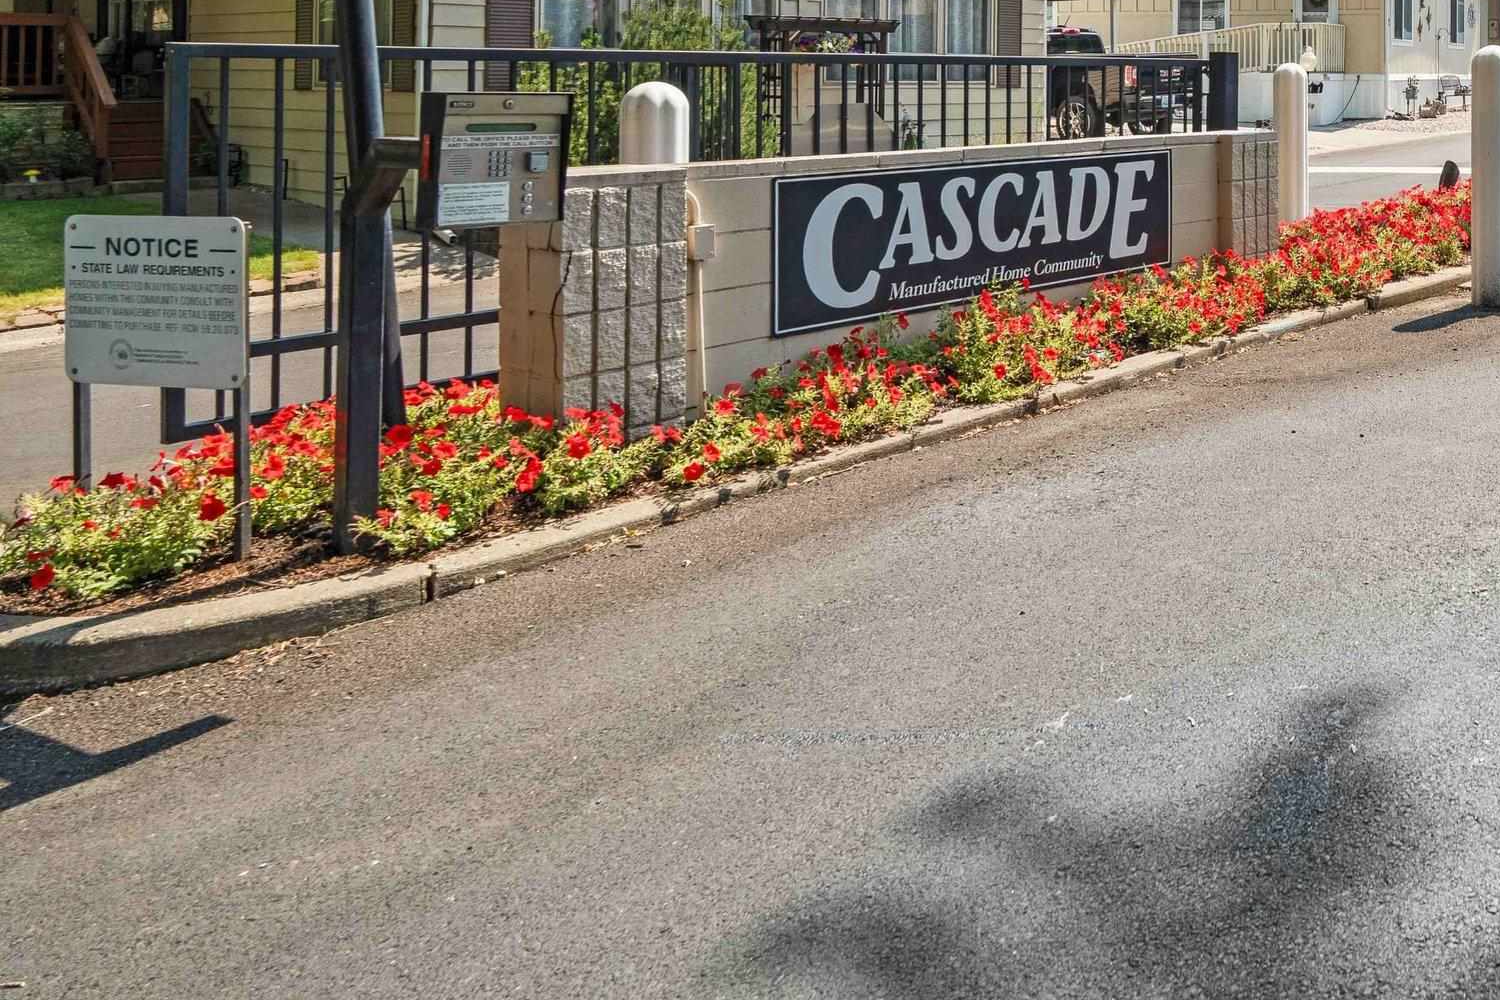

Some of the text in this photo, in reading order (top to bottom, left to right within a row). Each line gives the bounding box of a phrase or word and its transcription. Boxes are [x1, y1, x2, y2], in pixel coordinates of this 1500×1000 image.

[105, 237, 199, 258] NOTICE
[802, 159, 1155, 309] CASCADE
[81, 262, 224, 277] STATE LAW REQUIREMENTS
[889, 251, 1104, 300] Manufactured Home Community
